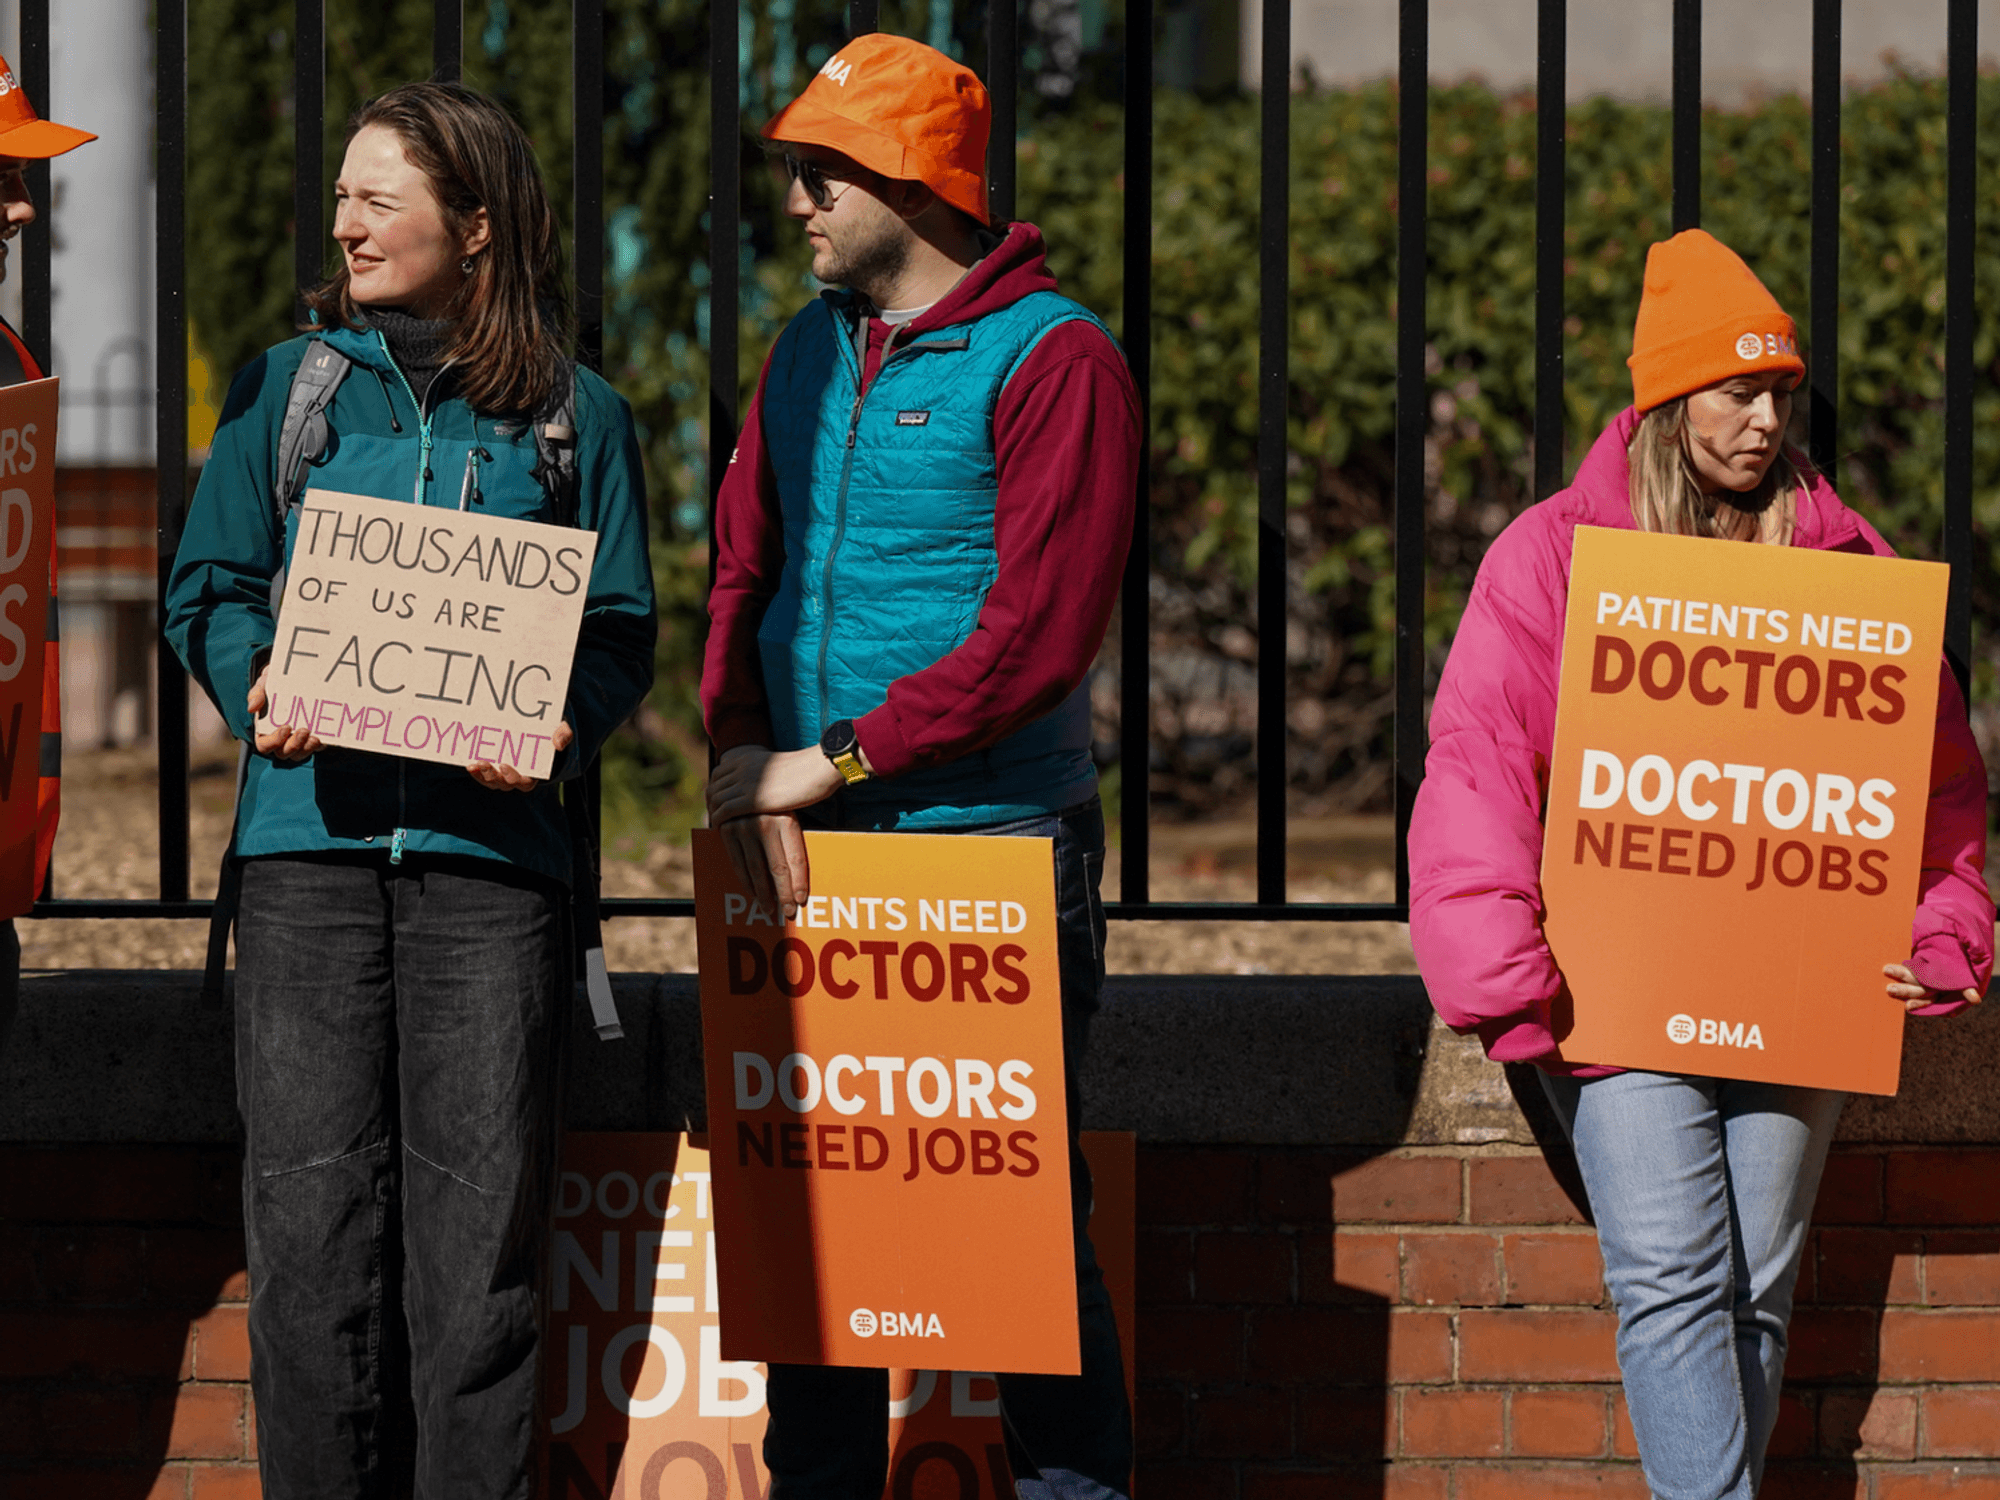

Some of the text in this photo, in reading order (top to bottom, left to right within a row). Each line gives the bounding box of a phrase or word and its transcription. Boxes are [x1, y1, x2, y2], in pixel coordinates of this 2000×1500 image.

[303, 507, 583, 596] THOUSANDS
[298, 577, 505, 633] OF US ARE
[1596, 591, 1913, 656] PATIENTS NEED
[282, 626, 553, 721] FACING
[1590, 634, 1908, 725] DOCTORS
[270, 693, 552, 770] UNEMPLOYMENT
[1578, 749, 1897, 840] DOCTORS
[1573, 819, 1891, 897] NEED JOBS
[918, 899, 1028, 933] NEED
[727, 936, 1031, 1005] DOCTORS
[1699, 1018, 1765, 1051] BMA
[732, 1051, 1038, 1121] DOCTORS
[737, 1121, 1041, 1182] NEED JOBS
[880, 1311, 945, 1338] BMA
